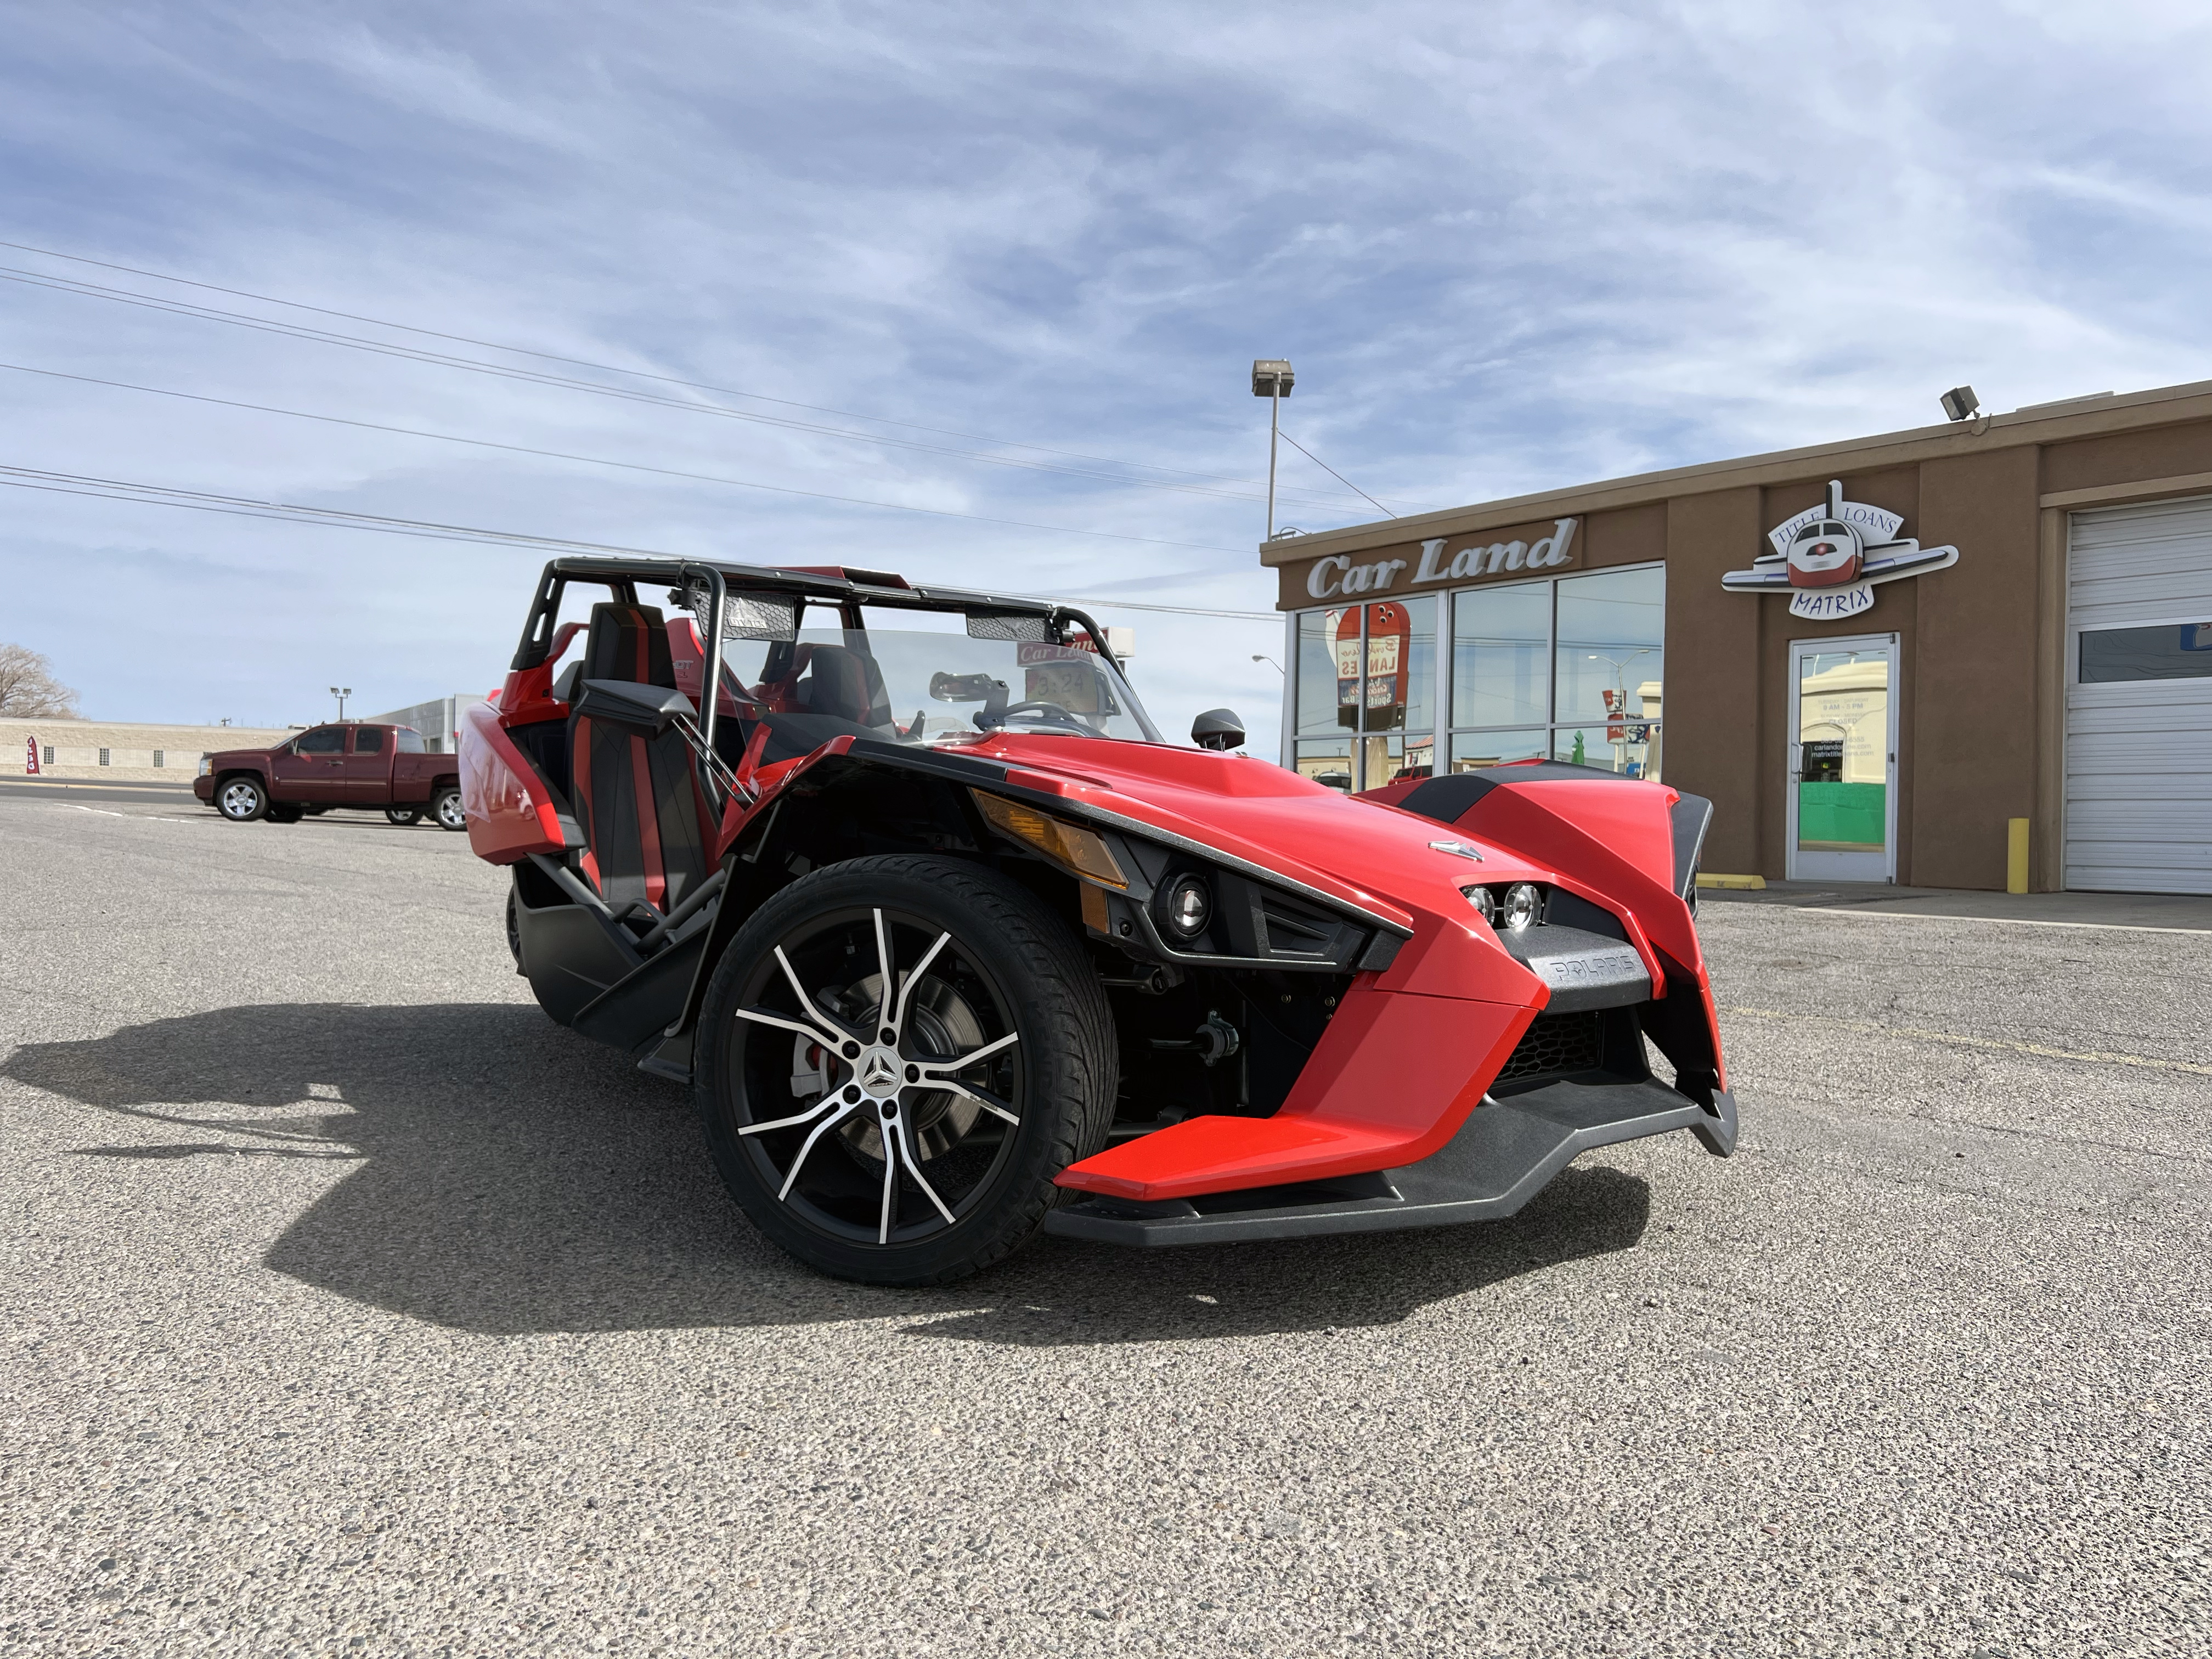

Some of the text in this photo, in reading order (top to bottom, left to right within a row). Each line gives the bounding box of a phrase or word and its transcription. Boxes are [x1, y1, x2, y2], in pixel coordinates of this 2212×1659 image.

[1844, 507, 1897, 533] LOANS
[1306, 517, 1578, 599] Car Land
[1793, 584, 1869, 615] MATRIX
[1020, 646, 1051, 662] Car
[1038, 674, 1084, 696] 3:24
[1550, 956, 1636, 981] POLARIS
